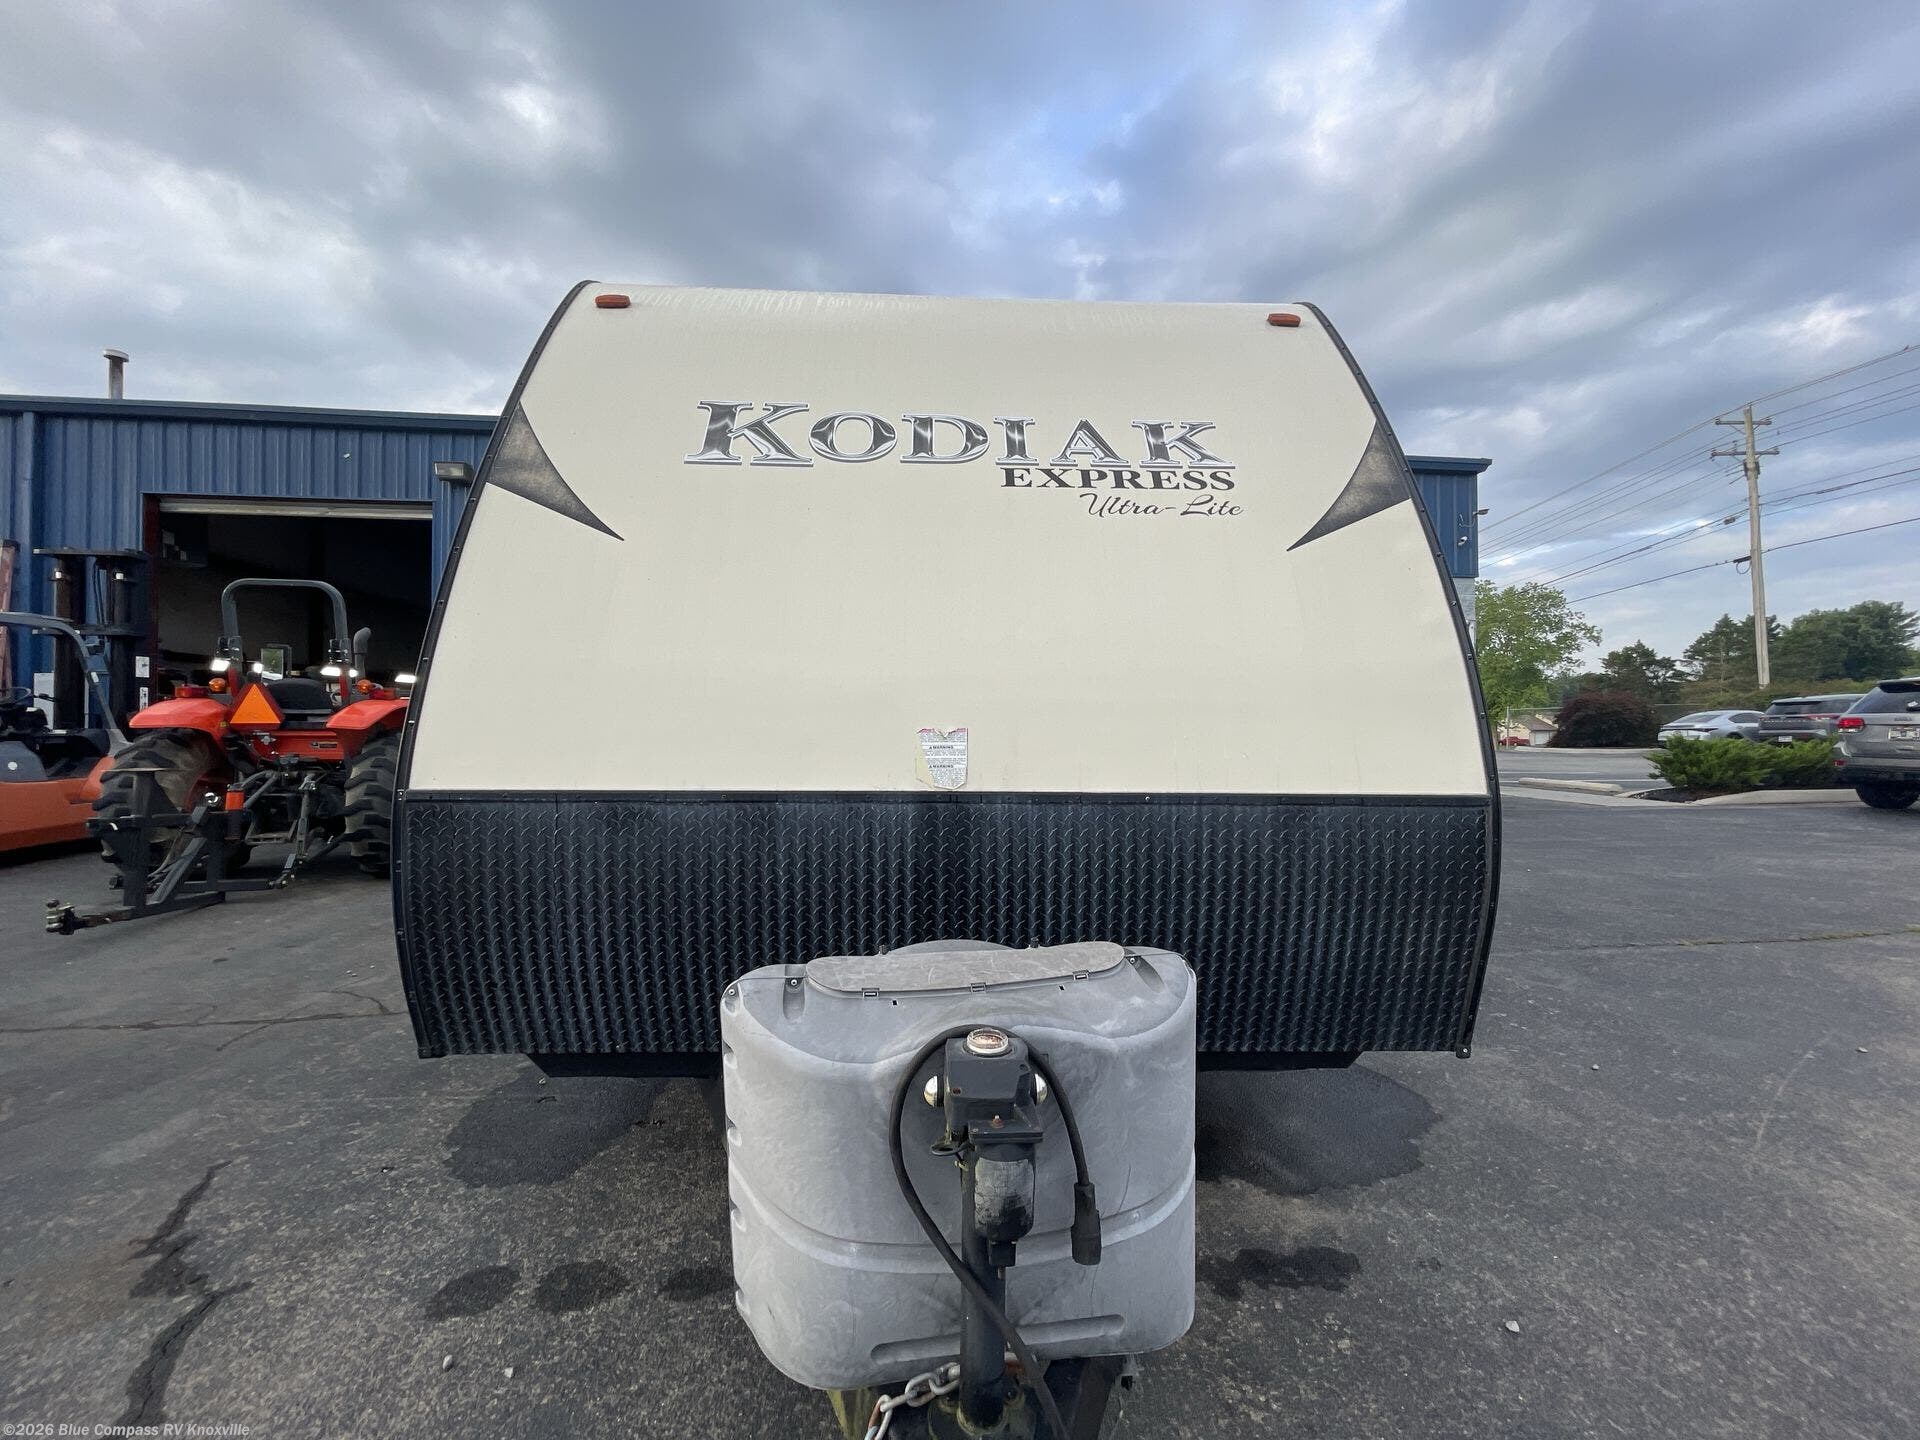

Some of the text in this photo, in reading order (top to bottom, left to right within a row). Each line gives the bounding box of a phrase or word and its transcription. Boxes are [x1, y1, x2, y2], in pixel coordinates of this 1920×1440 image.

[683, 400, 1236, 468] KODIAK
[1001, 467, 1236, 491] EXPRESS
[1079, 492, 1244, 518] Ultra-Lite
